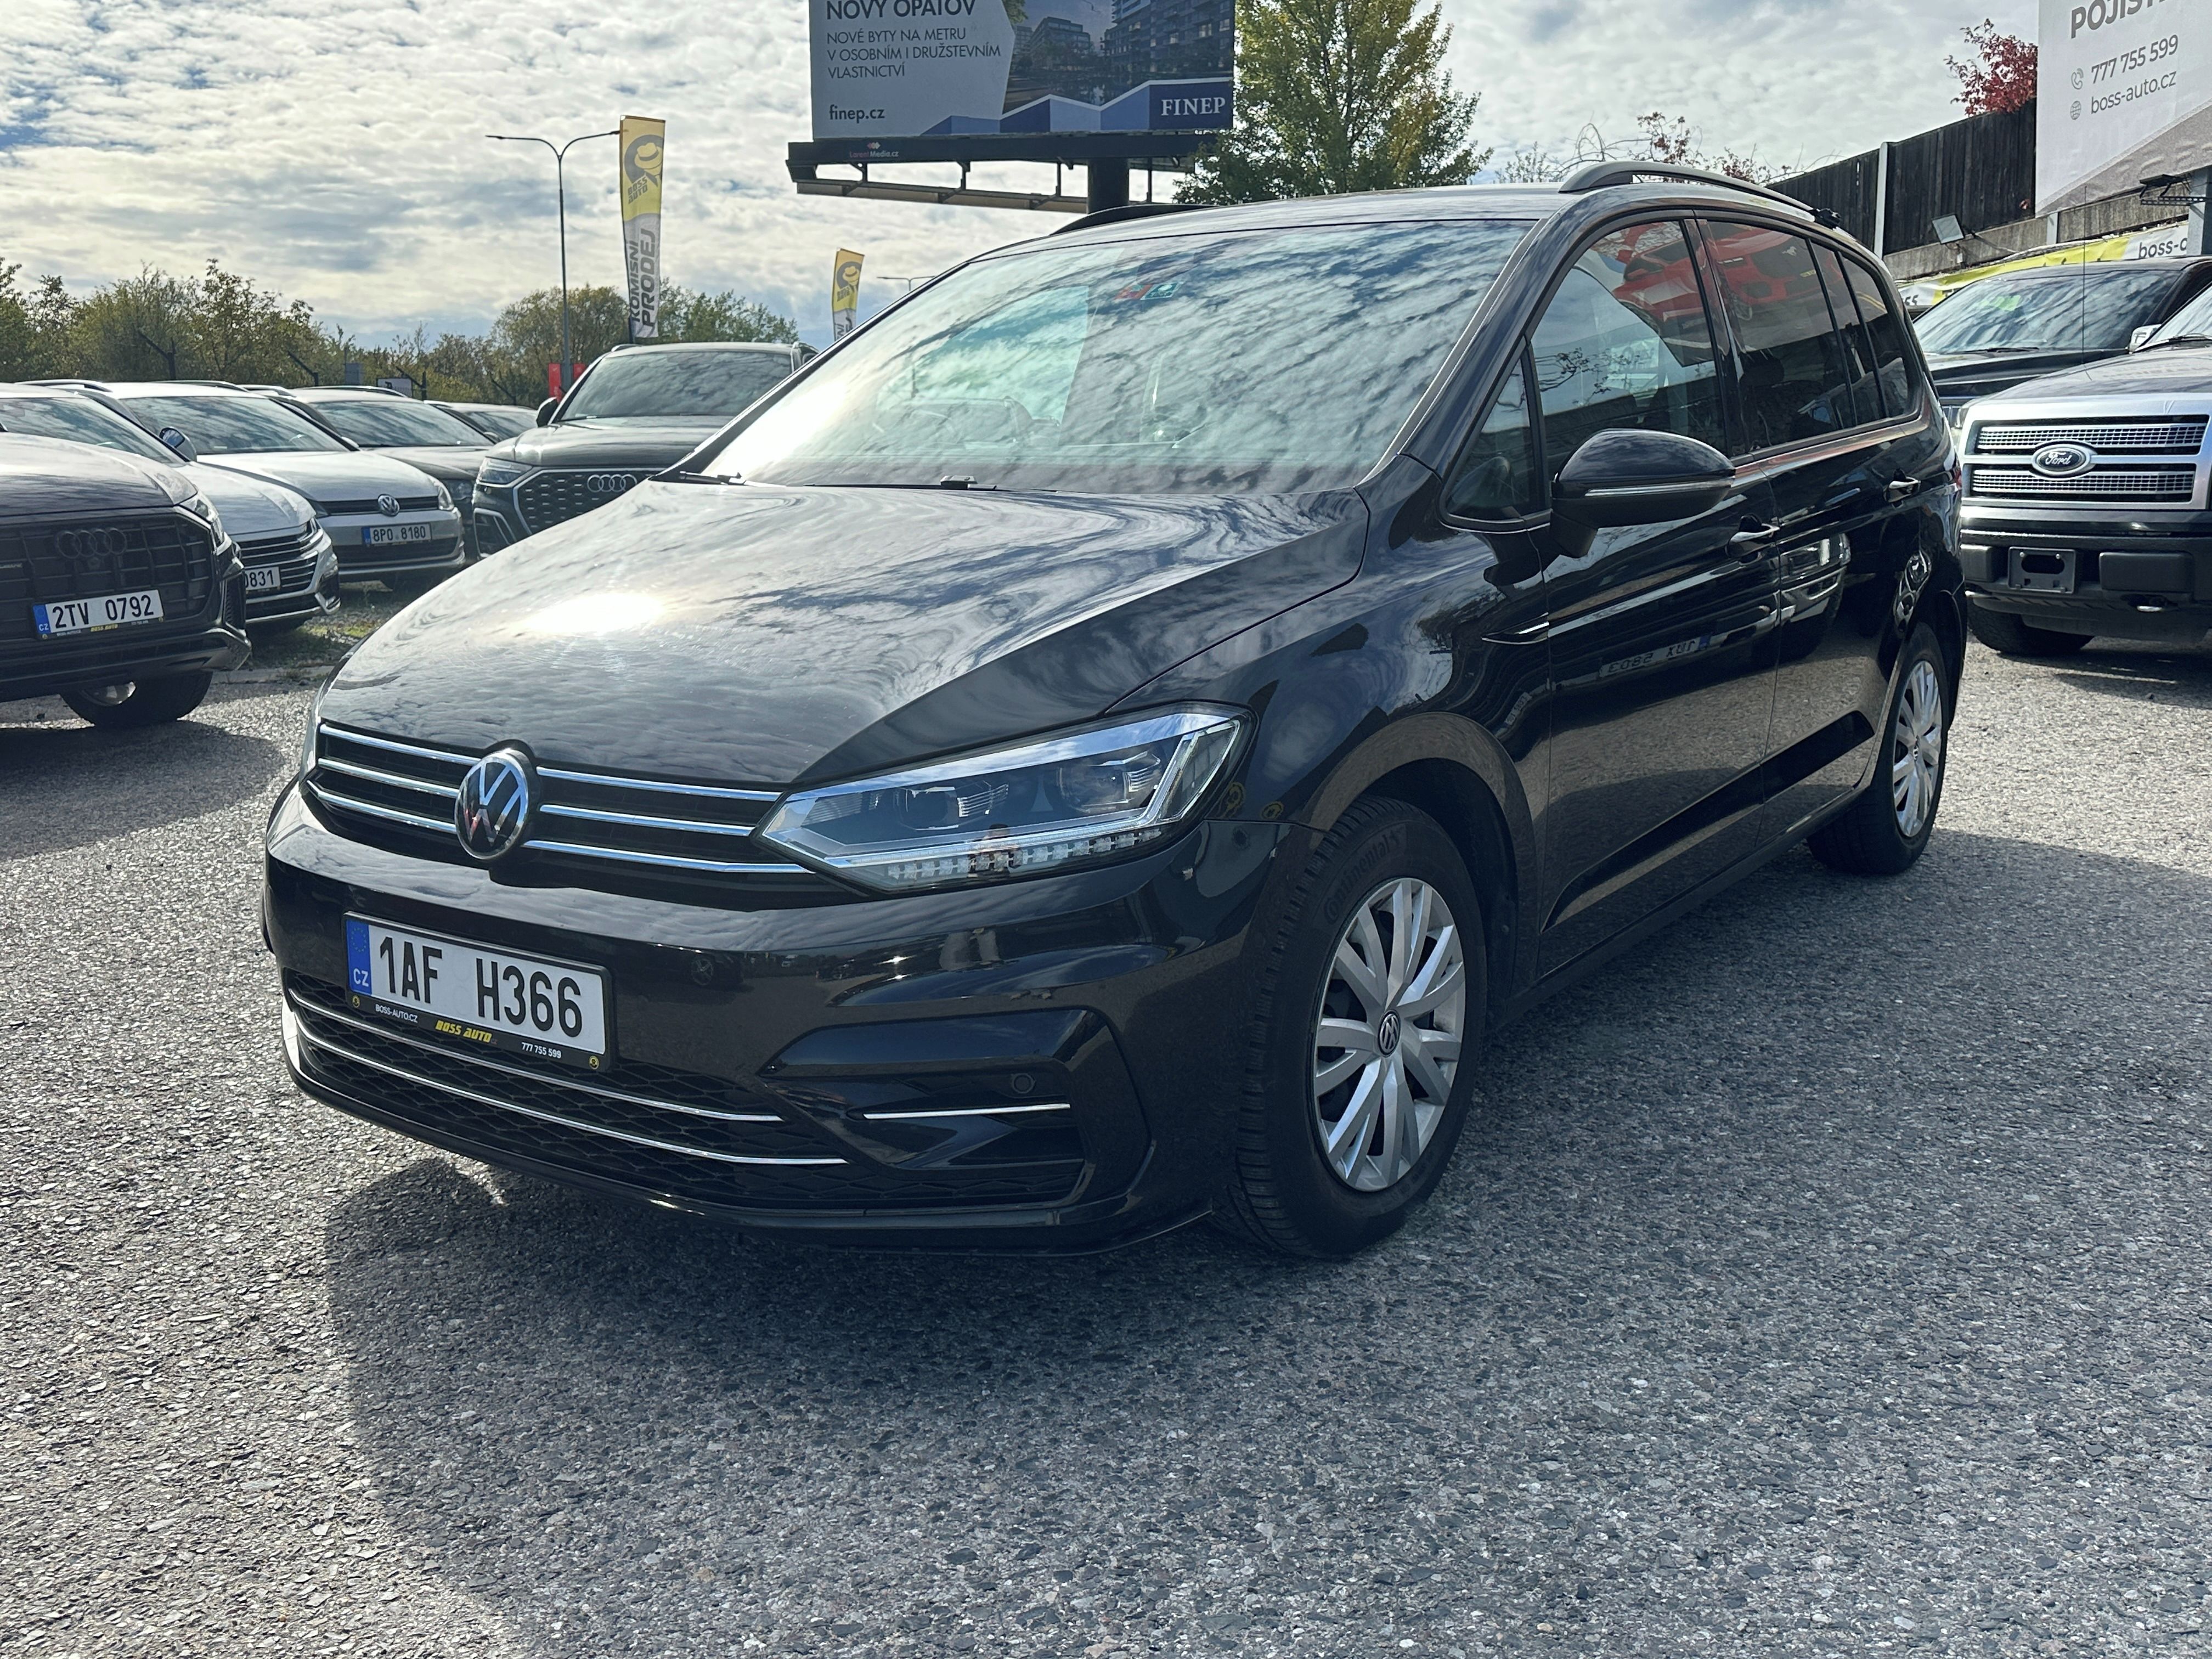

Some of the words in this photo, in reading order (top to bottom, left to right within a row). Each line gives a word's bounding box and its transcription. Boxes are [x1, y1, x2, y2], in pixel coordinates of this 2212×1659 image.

[827, 29, 864, 44] NOVÉ
[868, 30, 896, 43] BYTY
[901, 29, 921, 41] NA
[924, 27, 966, 41] METRU
[827, 50, 836, 61] V
[839, 44, 902, 61] OSOBNÍM
[913, 42, 1001, 59] DRUŽSTEVNÍM
[2091, 57, 2117, 84] 777
[2121, 46, 2146, 73] 755
[2149, 35, 2179, 62] 599
[827, 61, 906, 78] VLASTNICTVÍ
[2091, 71, 2177, 114] boss-auto.cz
[829, 106, 885, 123] finep.cz
[1161, 97, 1226, 116] FINEP
[628, 177, 647, 196] BOSS
[641, 228, 656, 327] PRODEJ
[2045, 452, 2072, 465] Ford
[400, 526, 426, 539] 8180
[53, 602, 89, 629] 2TV
[105, 595, 154, 621] 0792
[38, 623, 49, 631] CZ
[1323, 834, 1391, 925] Continental
[353, 968, 369, 987] CZ
[380, 936, 442, 1004] 1AF
[476, 957, 582, 1037] H366
[375, 1003, 418, 1023] BOSS-AUTO.CZ
[435, 1019, 461, 1036] BOSS
[462, 1027, 492, 1043] AUTO
[521, 1041, 533, 1051] 777
[534, 1045, 547, 1056] 755
[548, 1048, 562, 1059] 599
